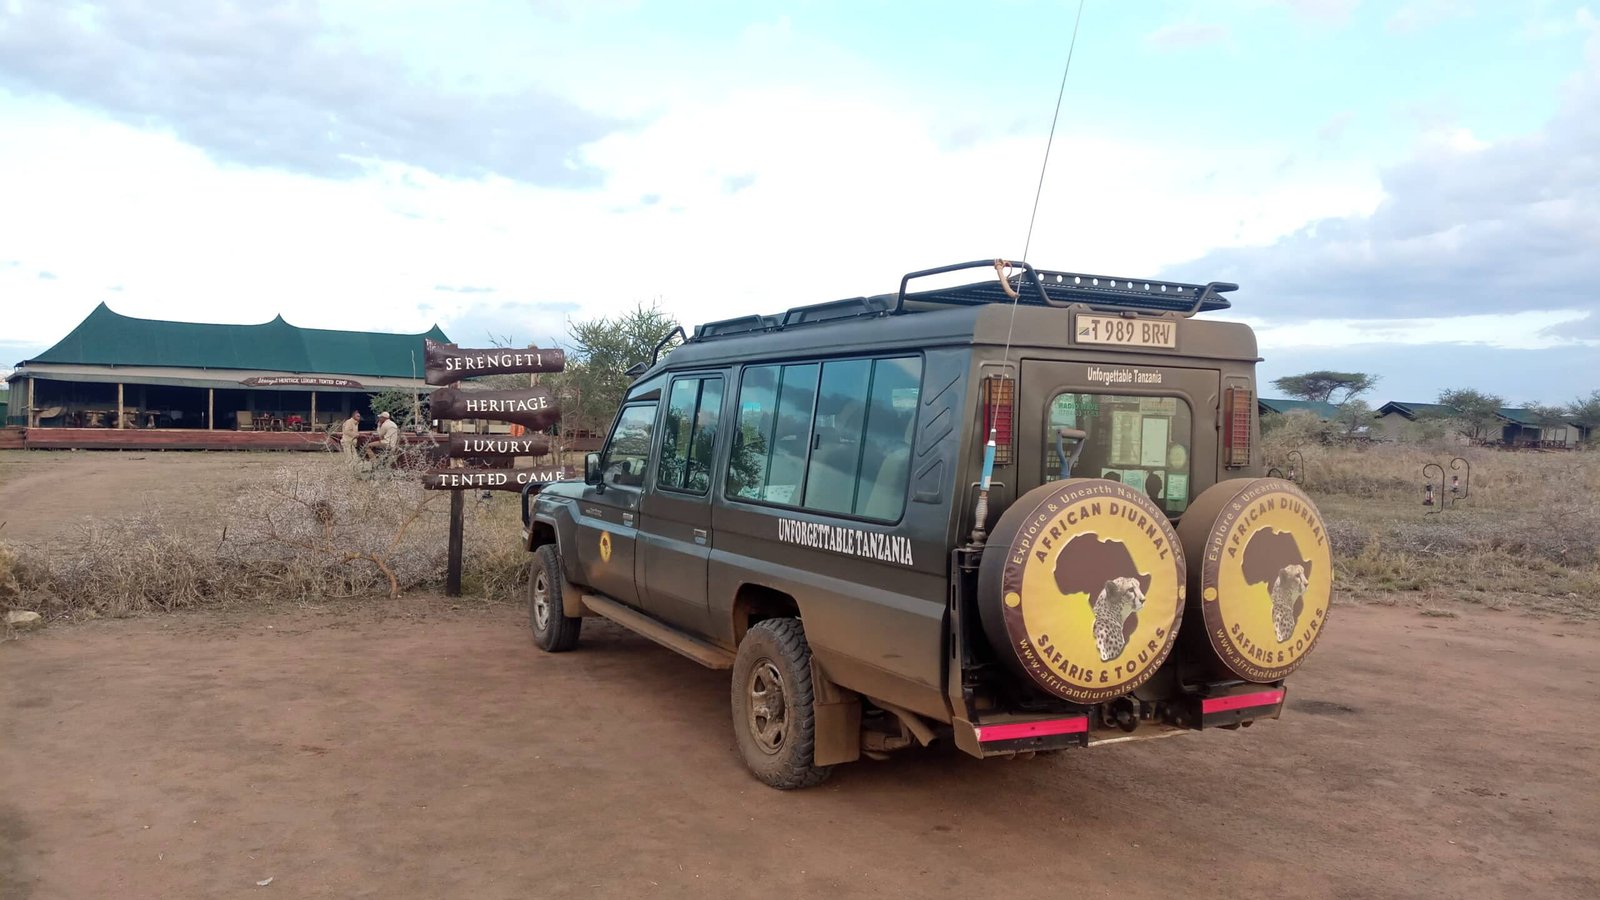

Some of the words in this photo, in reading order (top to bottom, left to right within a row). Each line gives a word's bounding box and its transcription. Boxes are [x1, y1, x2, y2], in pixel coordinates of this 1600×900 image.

[1091, 319, 1100, 341] T
[1105, 321, 1134, 343] 989
[1142, 322, 1171, 345] BRV
[446, 353, 542, 371] SERENGETI
[1087, 366, 1132, 386] Unforgettable
[1134, 369, 1162, 384] Tanzania
[467, 396, 548, 412] HERITAGE
[464, 440, 533, 453] LUXURY
[439, 473, 507, 487] TENTED
[778, 518, 855, 555] UNFORGETTABLE
[856, 529, 913, 566] TANZANIA
[1013, 514, 1047, 565] Explore
[1048, 503, 1058, 512] &
[1061, 485, 1112, 503] Unearth
[1117, 487, 1160, 519] Natures
[1036, 502, 1101, 563] AFRICAN
[1109, 502, 1169, 560] DIURNAL
[1209, 513, 1234, 561] Explore
[1232, 502, 1242, 511] &
[1241, 482, 1280, 502] Unearth
[1228, 498, 1275, 558] AFRICAN
[1280, 497, 1325, 546] DIURNAL
[1038, 634, 1093, 682] SAFARIS
[1100, 670, 1109, 683] &
[1115, 627, 1165, 679] TOURS
[1232, 623, 1273, 663] SAFARIS
[1277, 651, 1284, 662] &
[1288, 608, 1323, 657] TOURS
